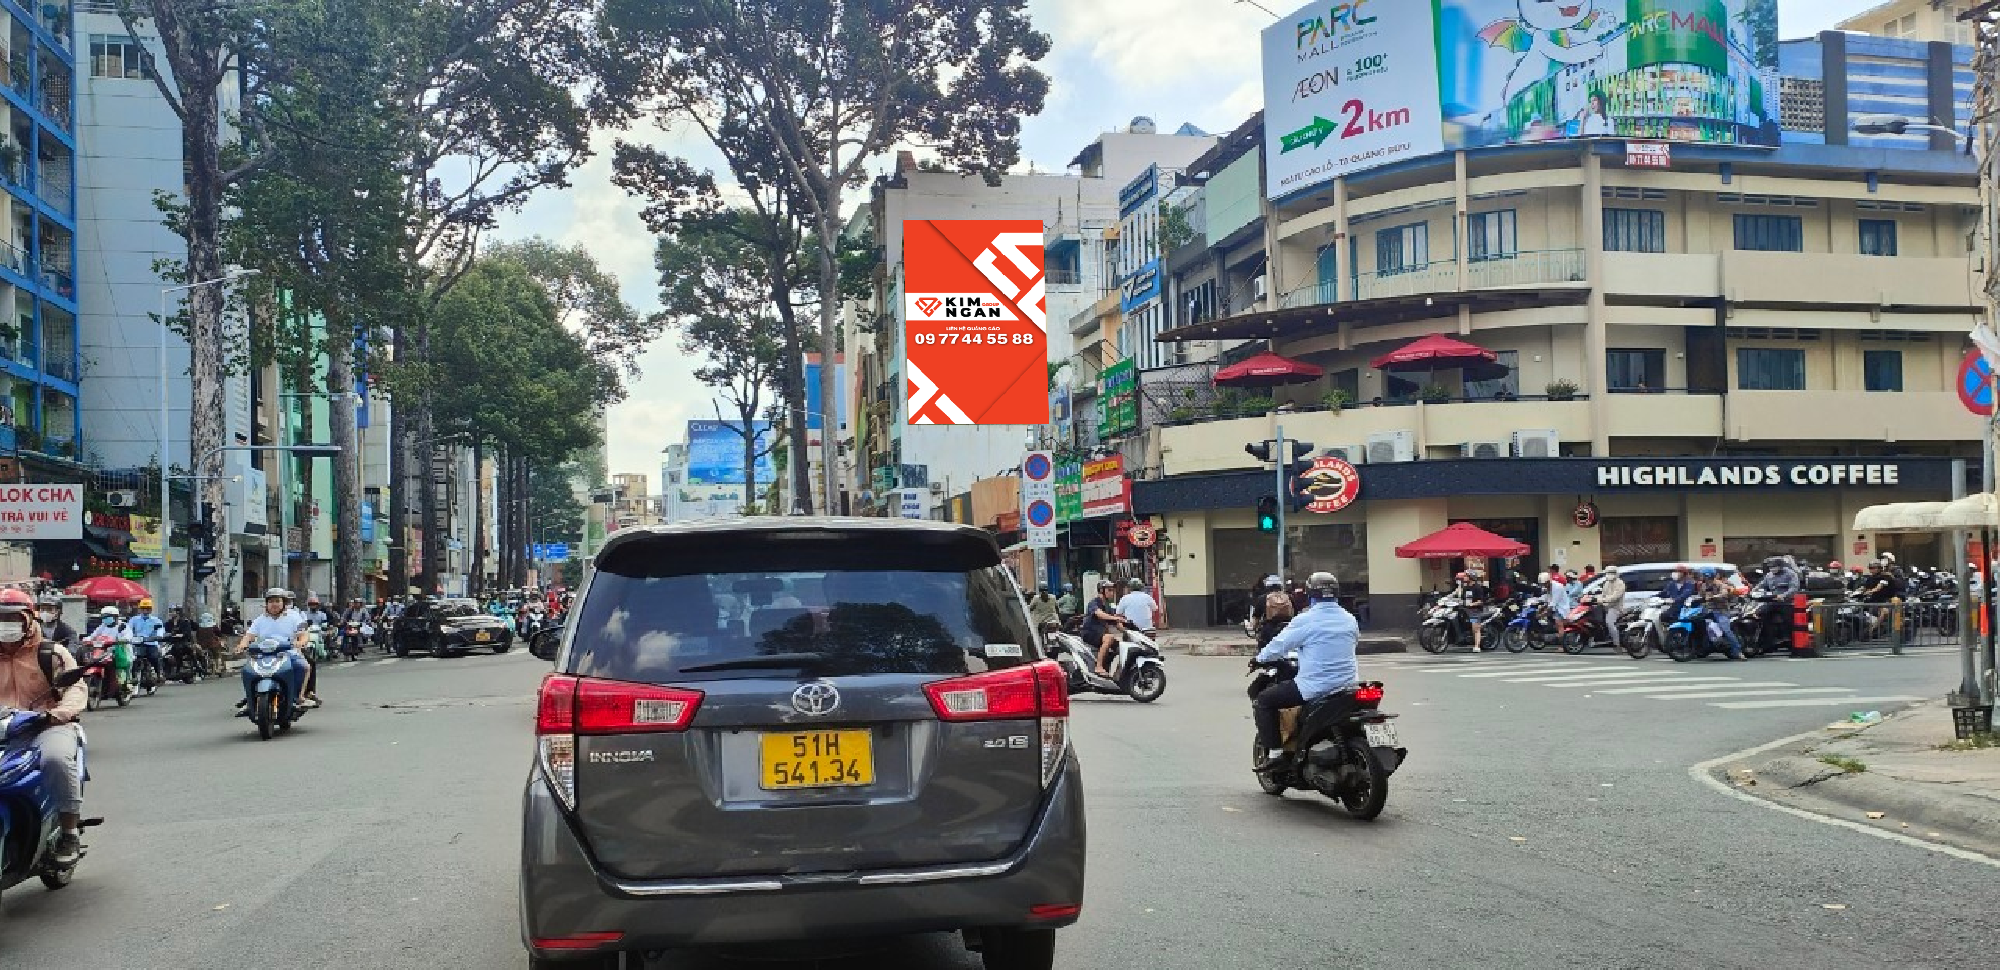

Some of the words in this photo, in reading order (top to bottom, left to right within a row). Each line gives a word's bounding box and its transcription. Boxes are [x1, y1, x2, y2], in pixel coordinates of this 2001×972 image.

[1297, 0, 1377, 50] PARC
[1297, 41, 1339, 63] MALL
[1341, 98, 1364, 139] 2
[1368, 107, 1410, 132] km
[945, 297, 981, 307] KIM
[945, 307, 1001, 318] NGAN
[1597, 465, 1781, 486] HIGHLANDS
[1791, 464, 1899, 485] COFFEE
[0, 488, 33, 503] LOK
[28, 511, 48, 522] VUI
[589, 749, 655, 763] INNOVA
[792, 734, 841, 757] 51H
[774, 759, 862, 785] 541.34
